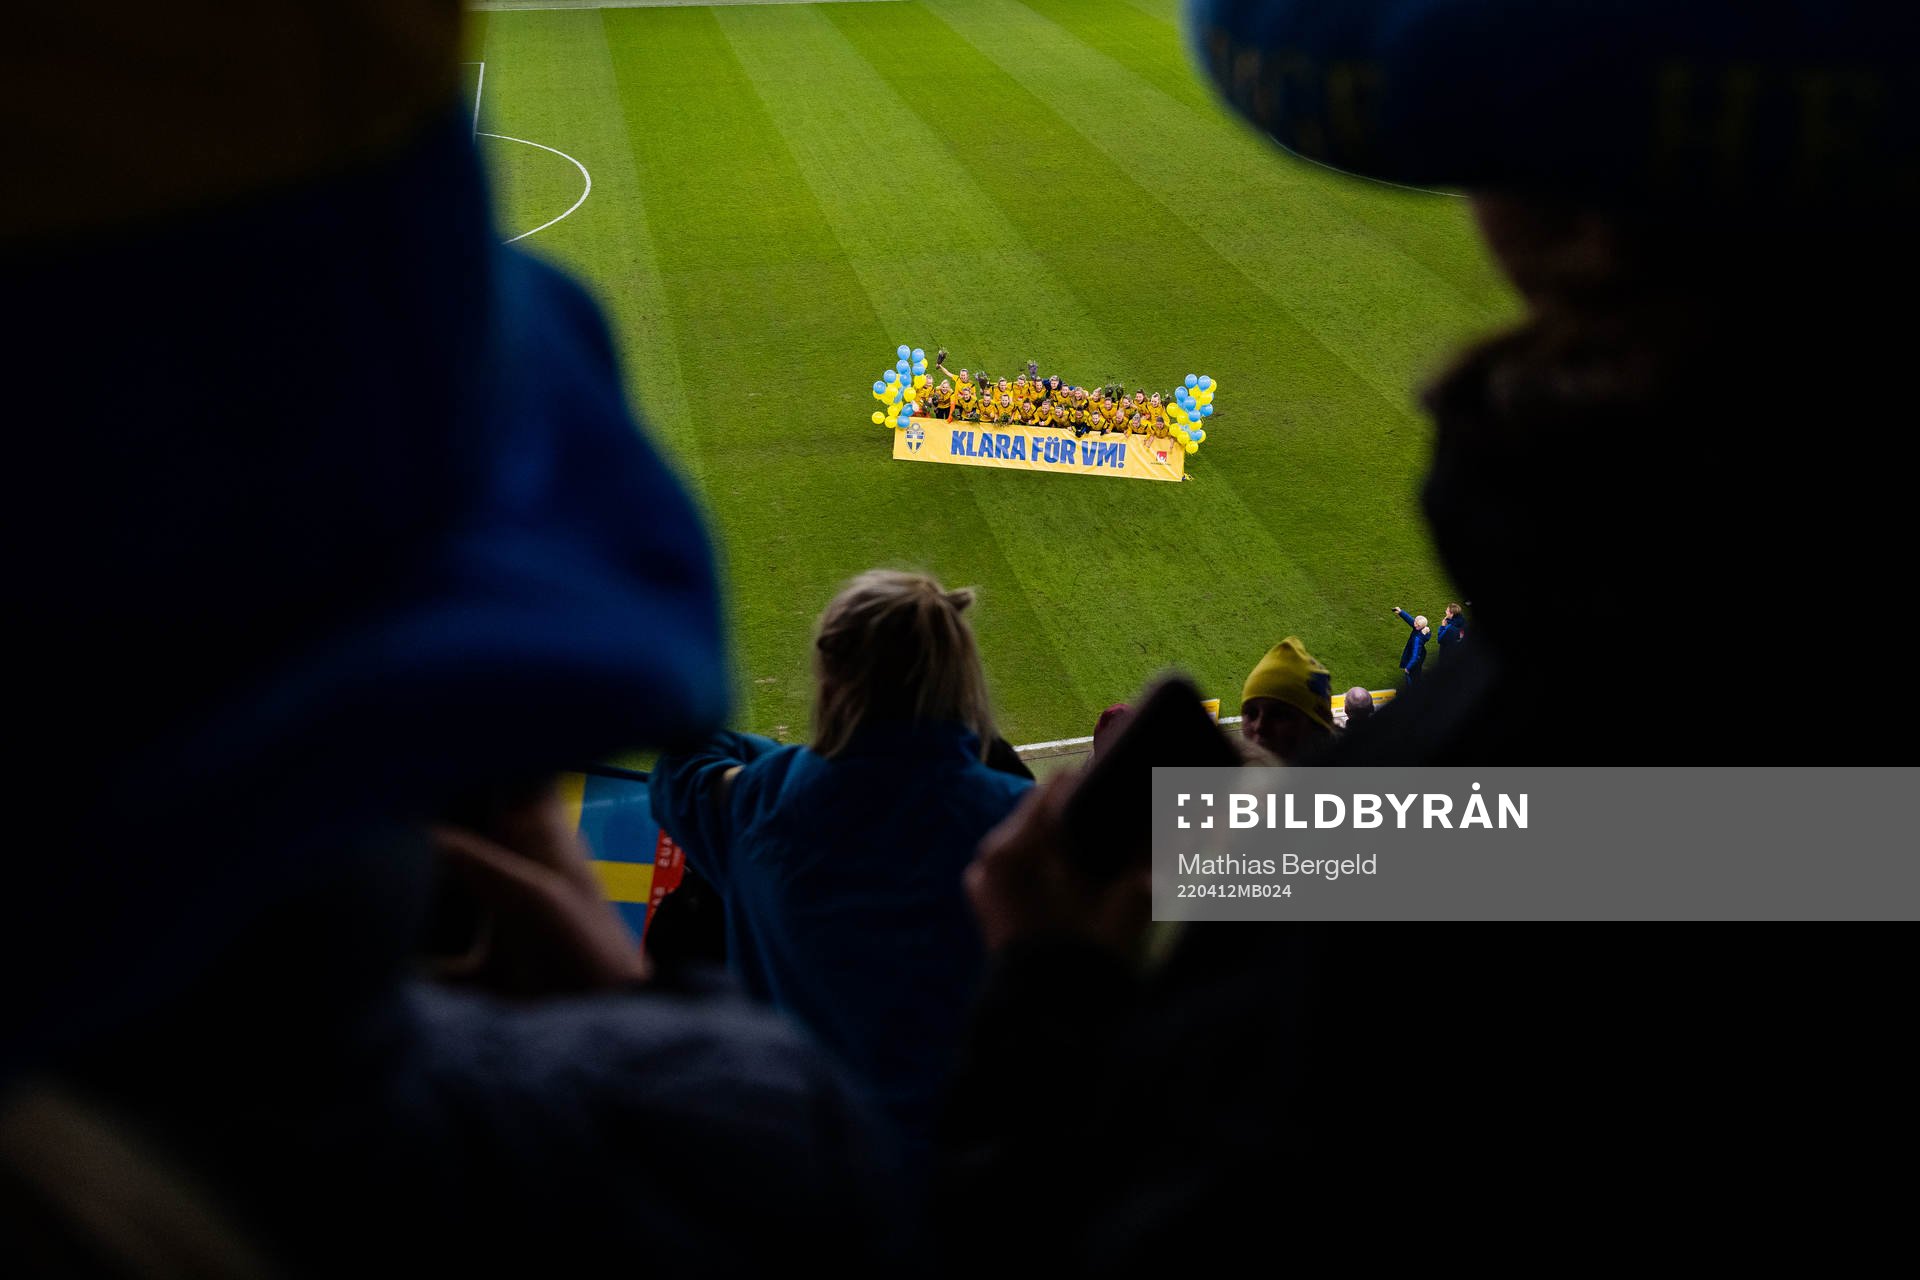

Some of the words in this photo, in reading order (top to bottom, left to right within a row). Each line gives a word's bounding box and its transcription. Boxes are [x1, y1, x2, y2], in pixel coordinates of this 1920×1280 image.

[951, 430, 1026, 461] KLARA
[1031, 436, 1077, 464] FÖR
[1082, 441, 1126, 468] VM!
